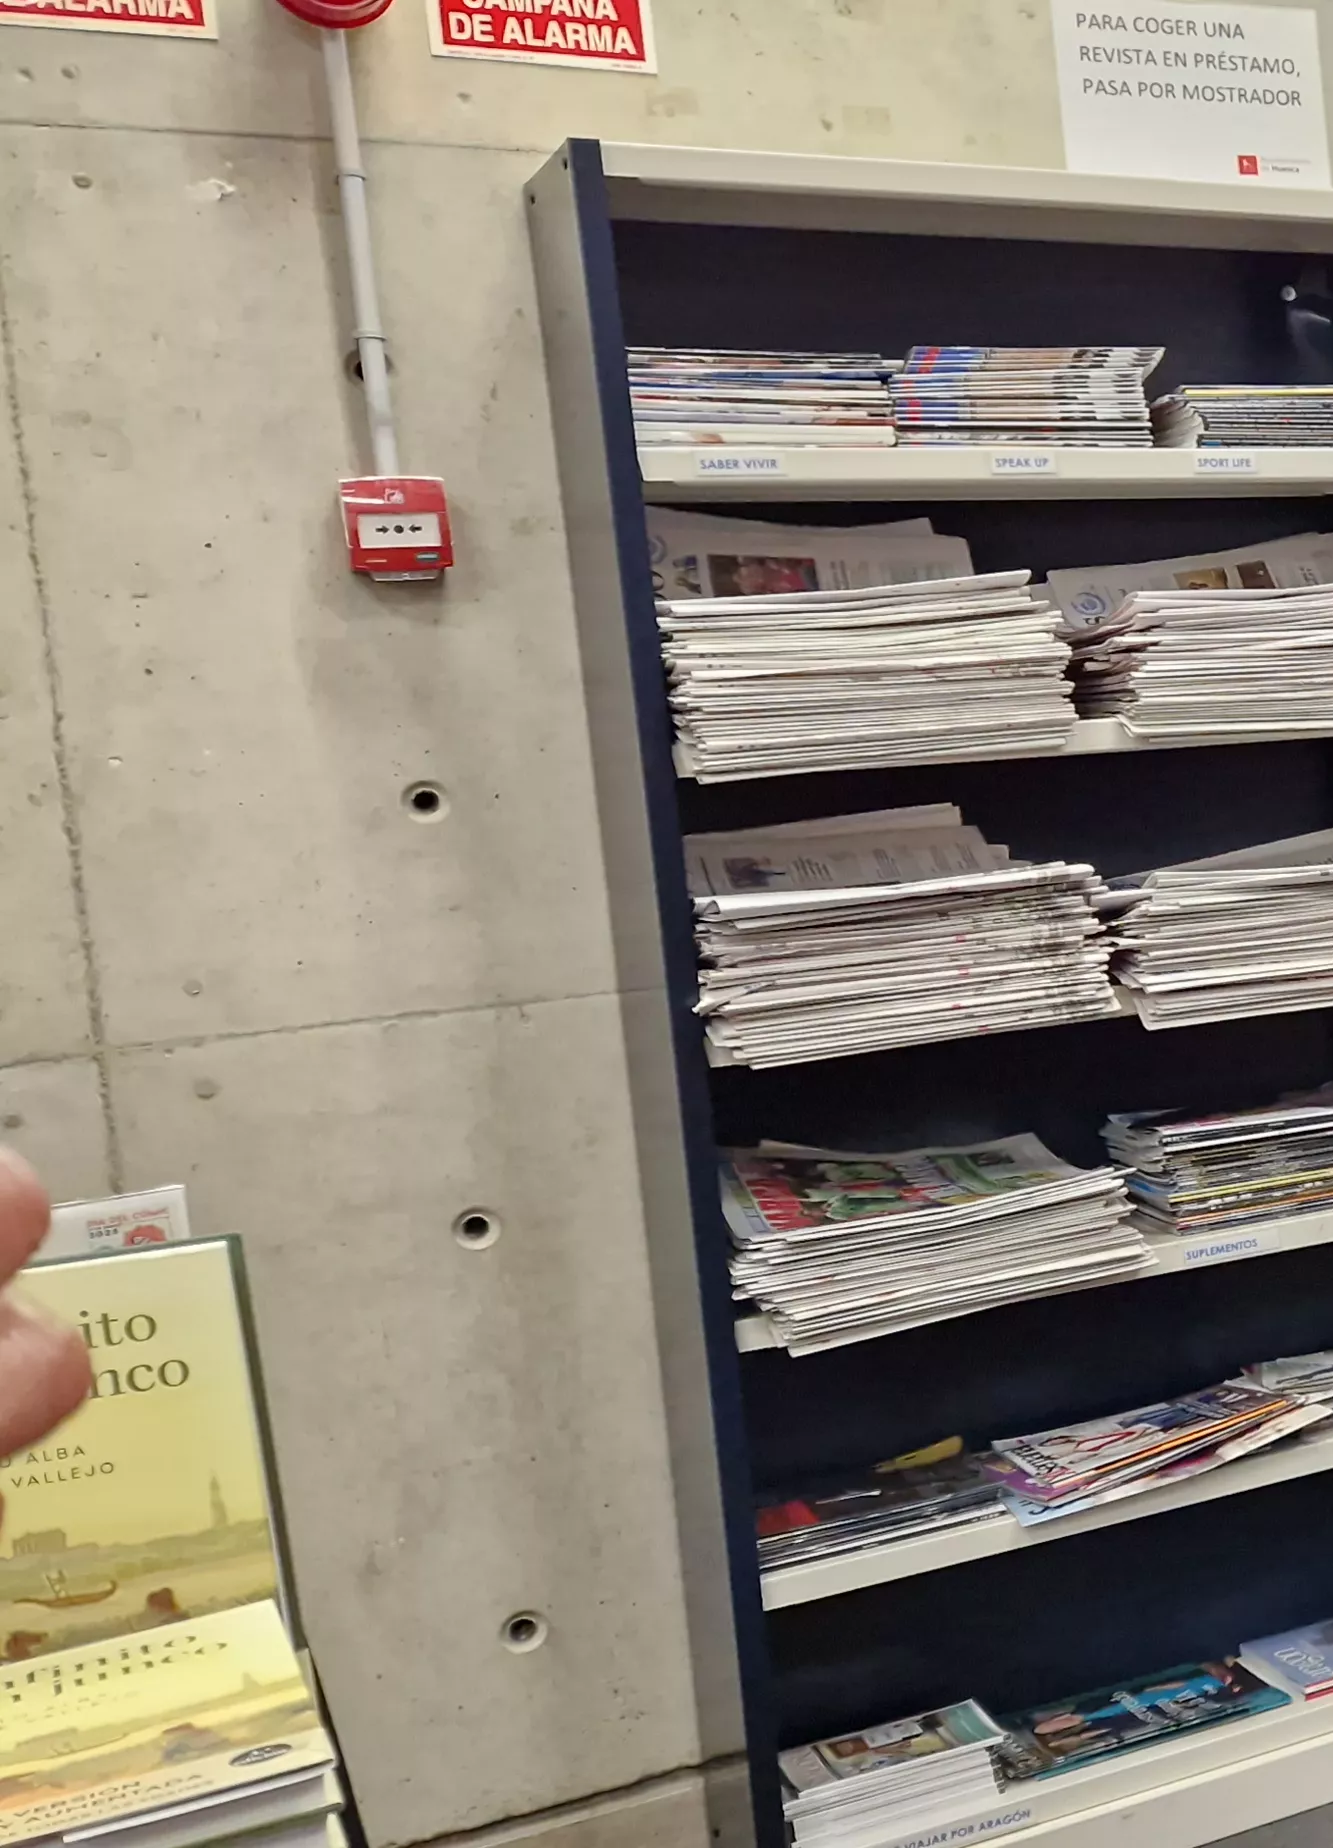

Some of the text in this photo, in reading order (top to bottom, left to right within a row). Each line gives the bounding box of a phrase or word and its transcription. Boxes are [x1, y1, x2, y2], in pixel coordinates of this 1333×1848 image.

[36, 0, 194, 19] ARMA
[448, 12, 637, 55] DE ALARMA
[1076, 13, 1245, 39] PARA COGER UNA
[1080, 46, 1300, 77] REVISTA EN PRÉSTAMO,
[1083, 78, 1301, 107] PASA POR MOSTRADOR
[700, 459, 778, 469] SABER VIVIR
[995, 458, 1049, 468] SPEAK UP
[1198, 458, 1252, 468] SPORT LIFE
[1186, 1238, 1259, 1260] SUPLEMENTOS
[26, 1446, 86, 1465] ALBA
[12, 1462, 115, 1488] VALLEJO
[951, 1824, 974, 1840] POR
[979, 1809, 1031, 1833] ARAGÓN
